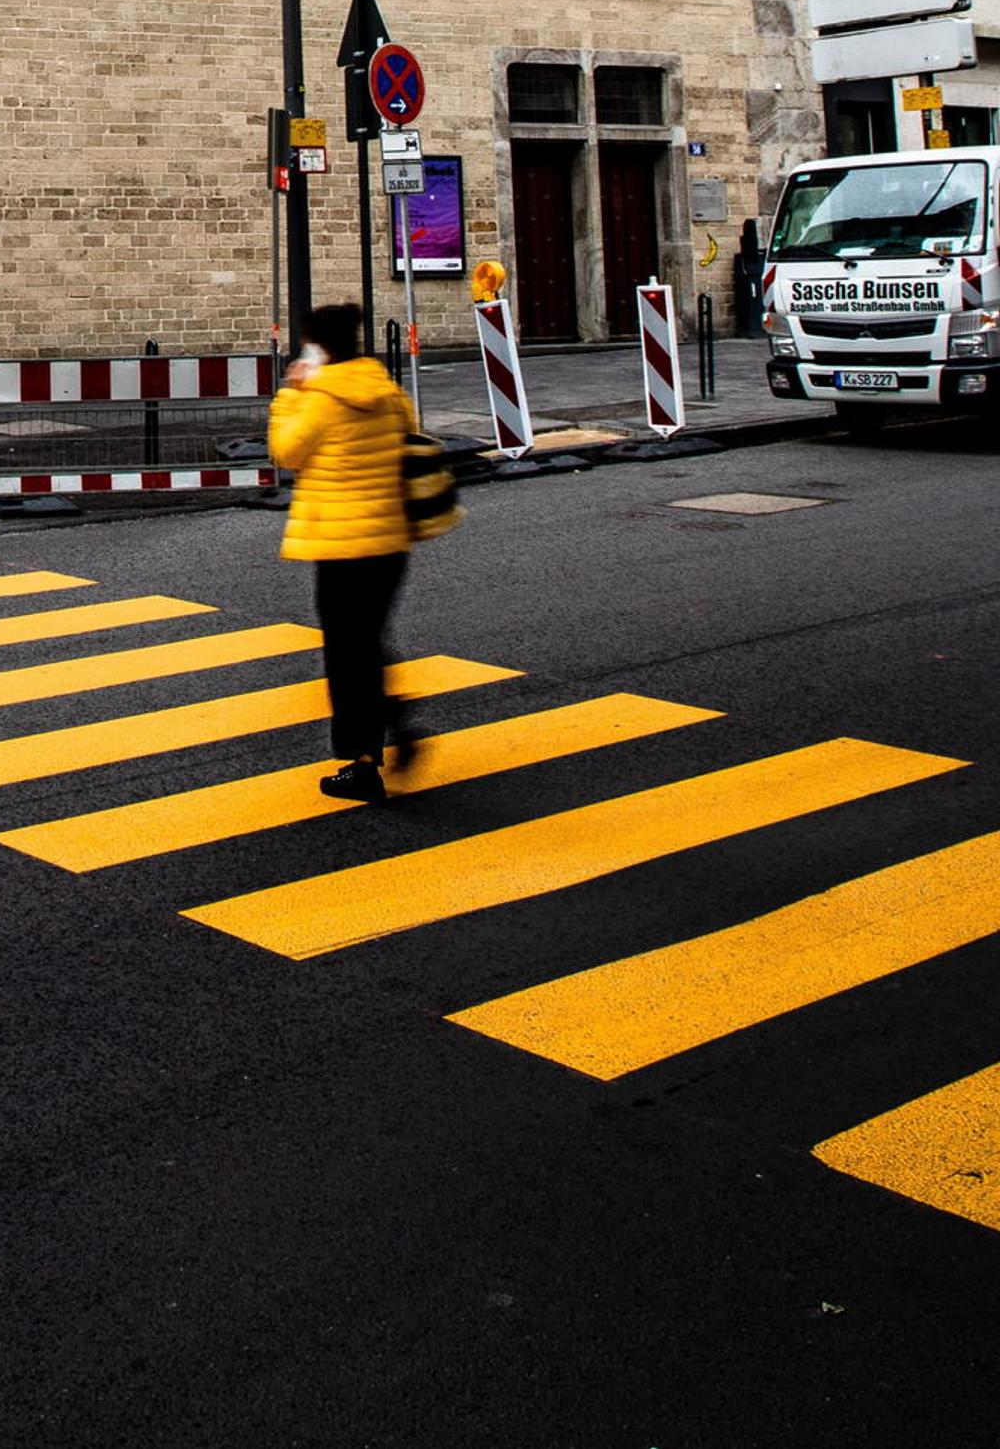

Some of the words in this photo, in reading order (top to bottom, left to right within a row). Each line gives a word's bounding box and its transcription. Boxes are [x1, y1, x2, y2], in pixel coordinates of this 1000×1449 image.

[791, 281, 858, 300] Sascha
[863, 280, 939, 299] Bunsen
[831, 302, 849, 312] und
[851, 301, 911, 312] Straßenbau
[913, 301, 945, 312] GmbH
